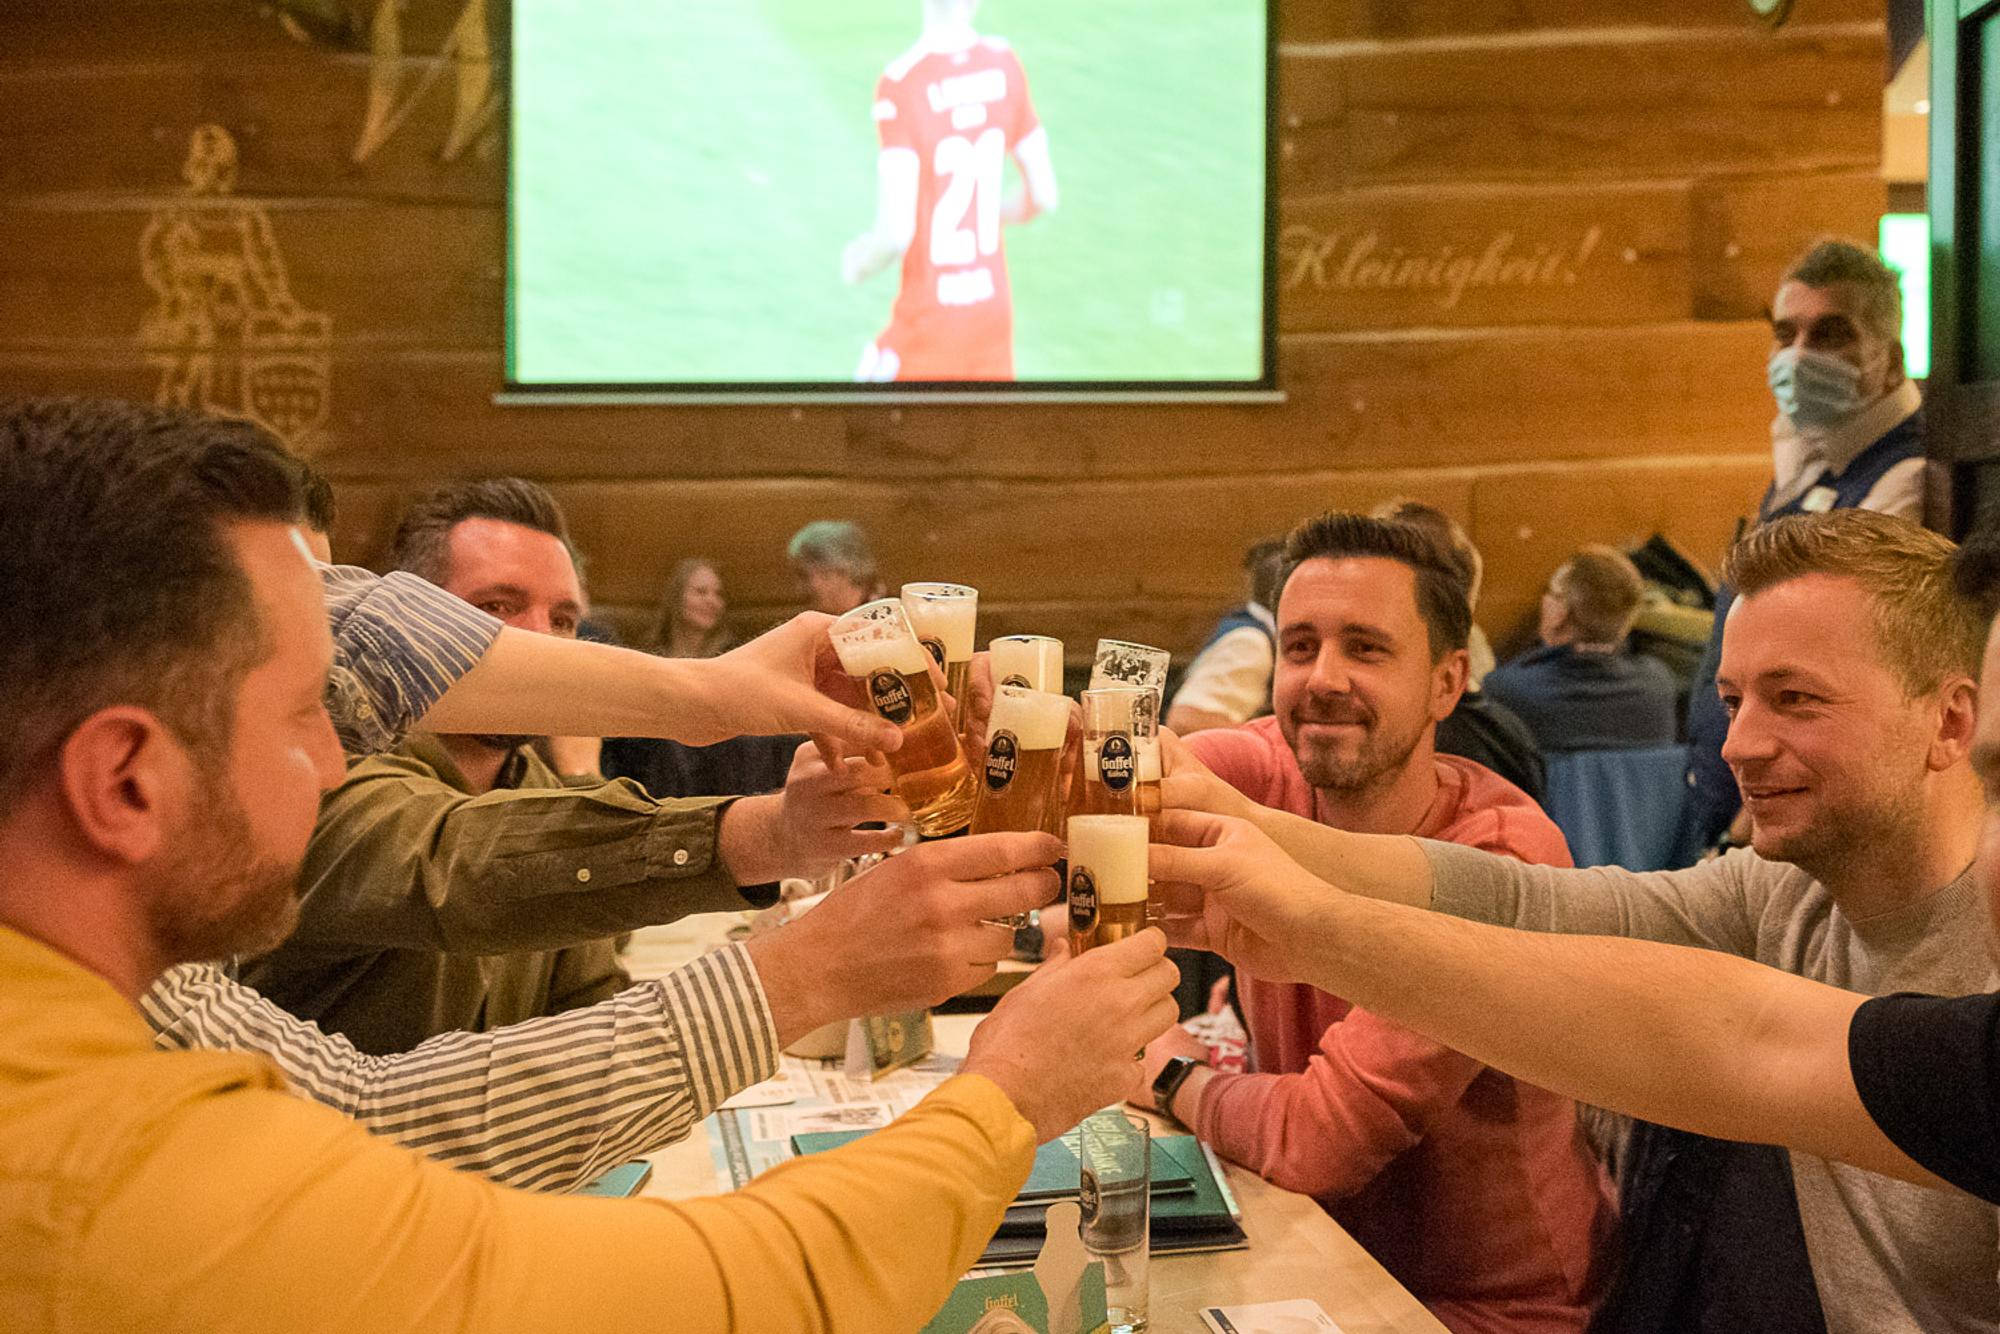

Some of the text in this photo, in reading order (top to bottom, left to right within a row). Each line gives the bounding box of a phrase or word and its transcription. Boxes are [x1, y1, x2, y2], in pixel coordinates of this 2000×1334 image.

[930, 127, 1005, 266] 21
[1280, 224, 1600, 308] Kleinigkeit!
[874, 686, 908, 706] Gaffel
[986, 754, 1015, 770] Gaffel
[1101, 756, 1133, 770] Gaffel
